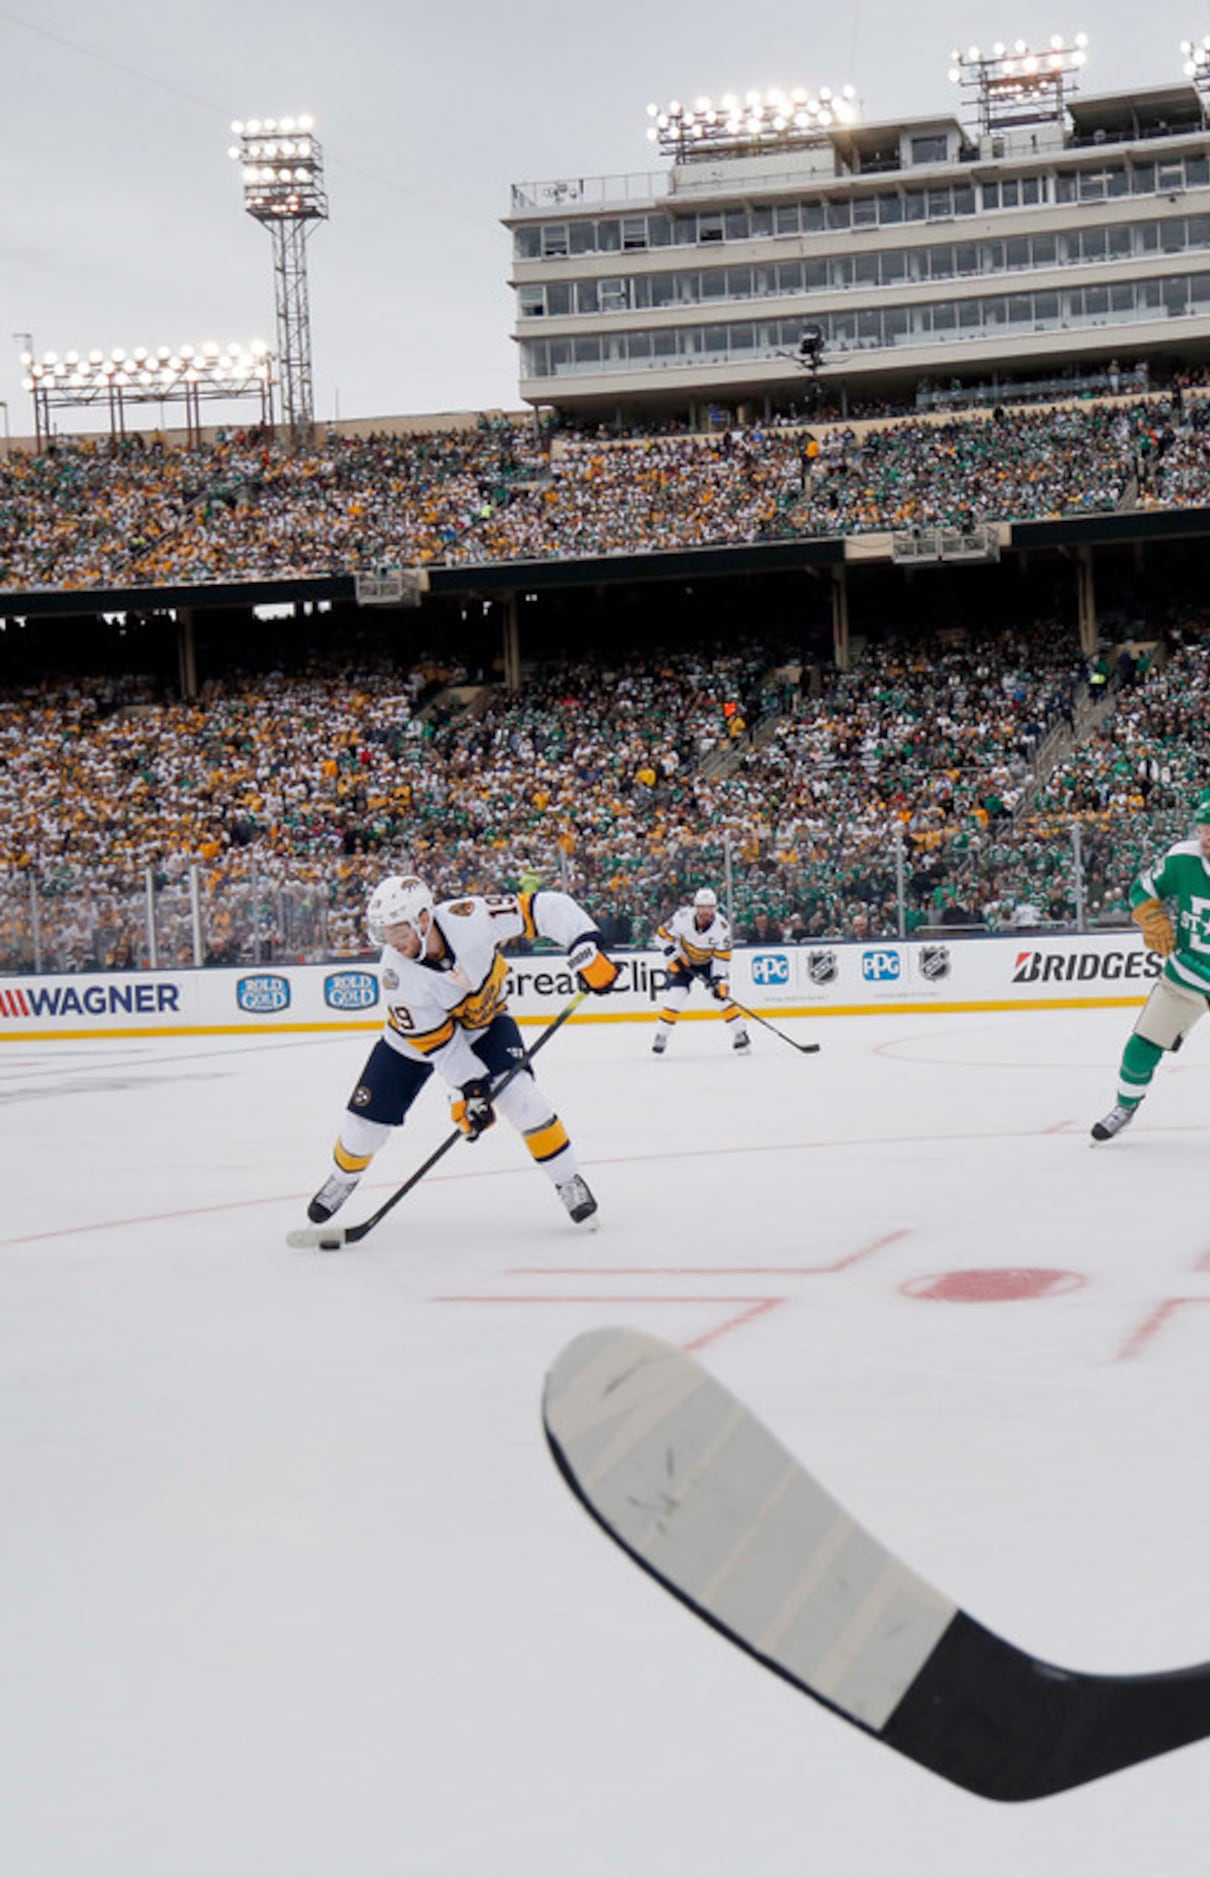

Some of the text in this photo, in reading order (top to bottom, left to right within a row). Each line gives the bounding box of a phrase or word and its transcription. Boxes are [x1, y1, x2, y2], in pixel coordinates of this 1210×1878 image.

[752, 957, 789, 983] PPG
[863, 953, 899, 979] PPG
[1012, 951, 1163, 983] BRIDGES
[26, 983, 180, 1017] WAGNER
[329, 988, 375, 1006] GOLD
